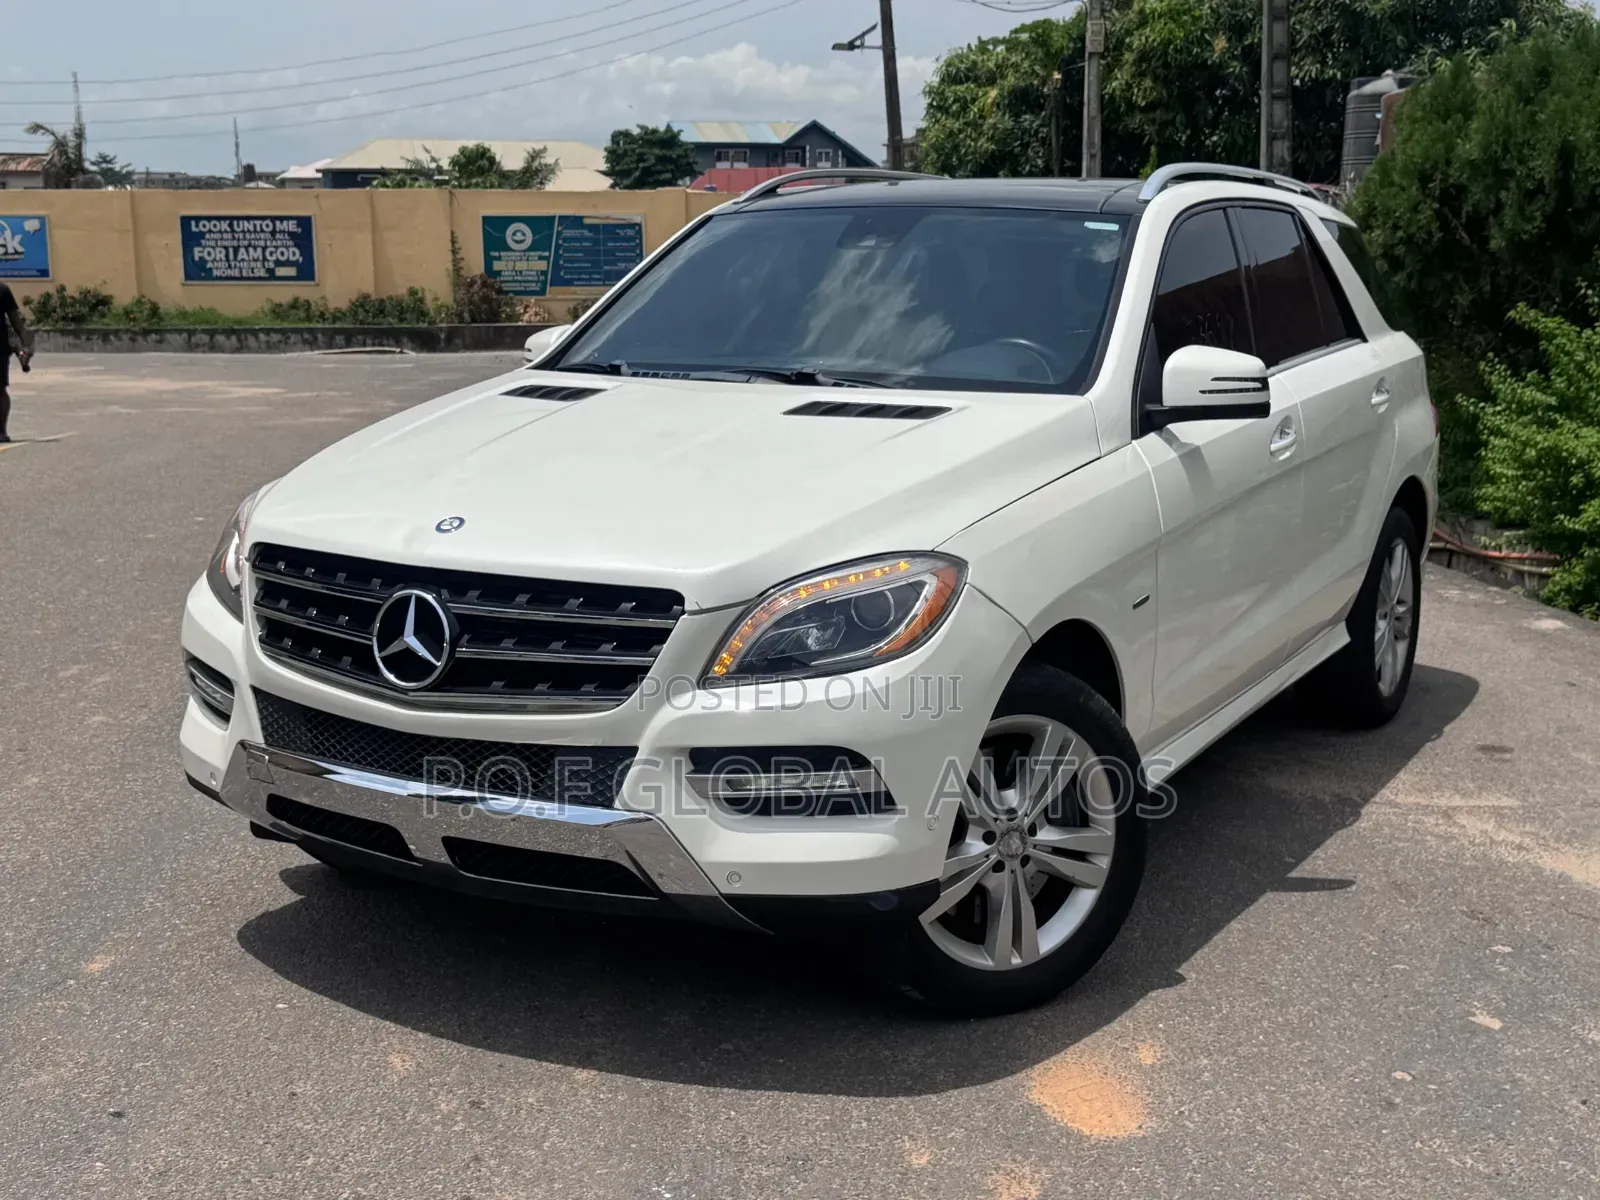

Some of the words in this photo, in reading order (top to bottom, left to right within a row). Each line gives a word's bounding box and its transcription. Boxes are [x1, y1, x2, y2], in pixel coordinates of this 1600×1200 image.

[191, 220, 231, 232] LOOK
[233, 219, 273, 232] UNTO
[276, 220, 302, 234] ME,
[193, 247, 226, 261] FOR
[229, 247, 234, 261] I
[237, 247, 263, 261] AM
[265, 247, 303, 264] GOD,
[206, 261, 228, 269] AND
[230, 261, 261, 269] THERE
[264, 261, 275, 269] IS
[213, 268, 241, 277] NONE
[241, 268, 270, 277] ELSE.
